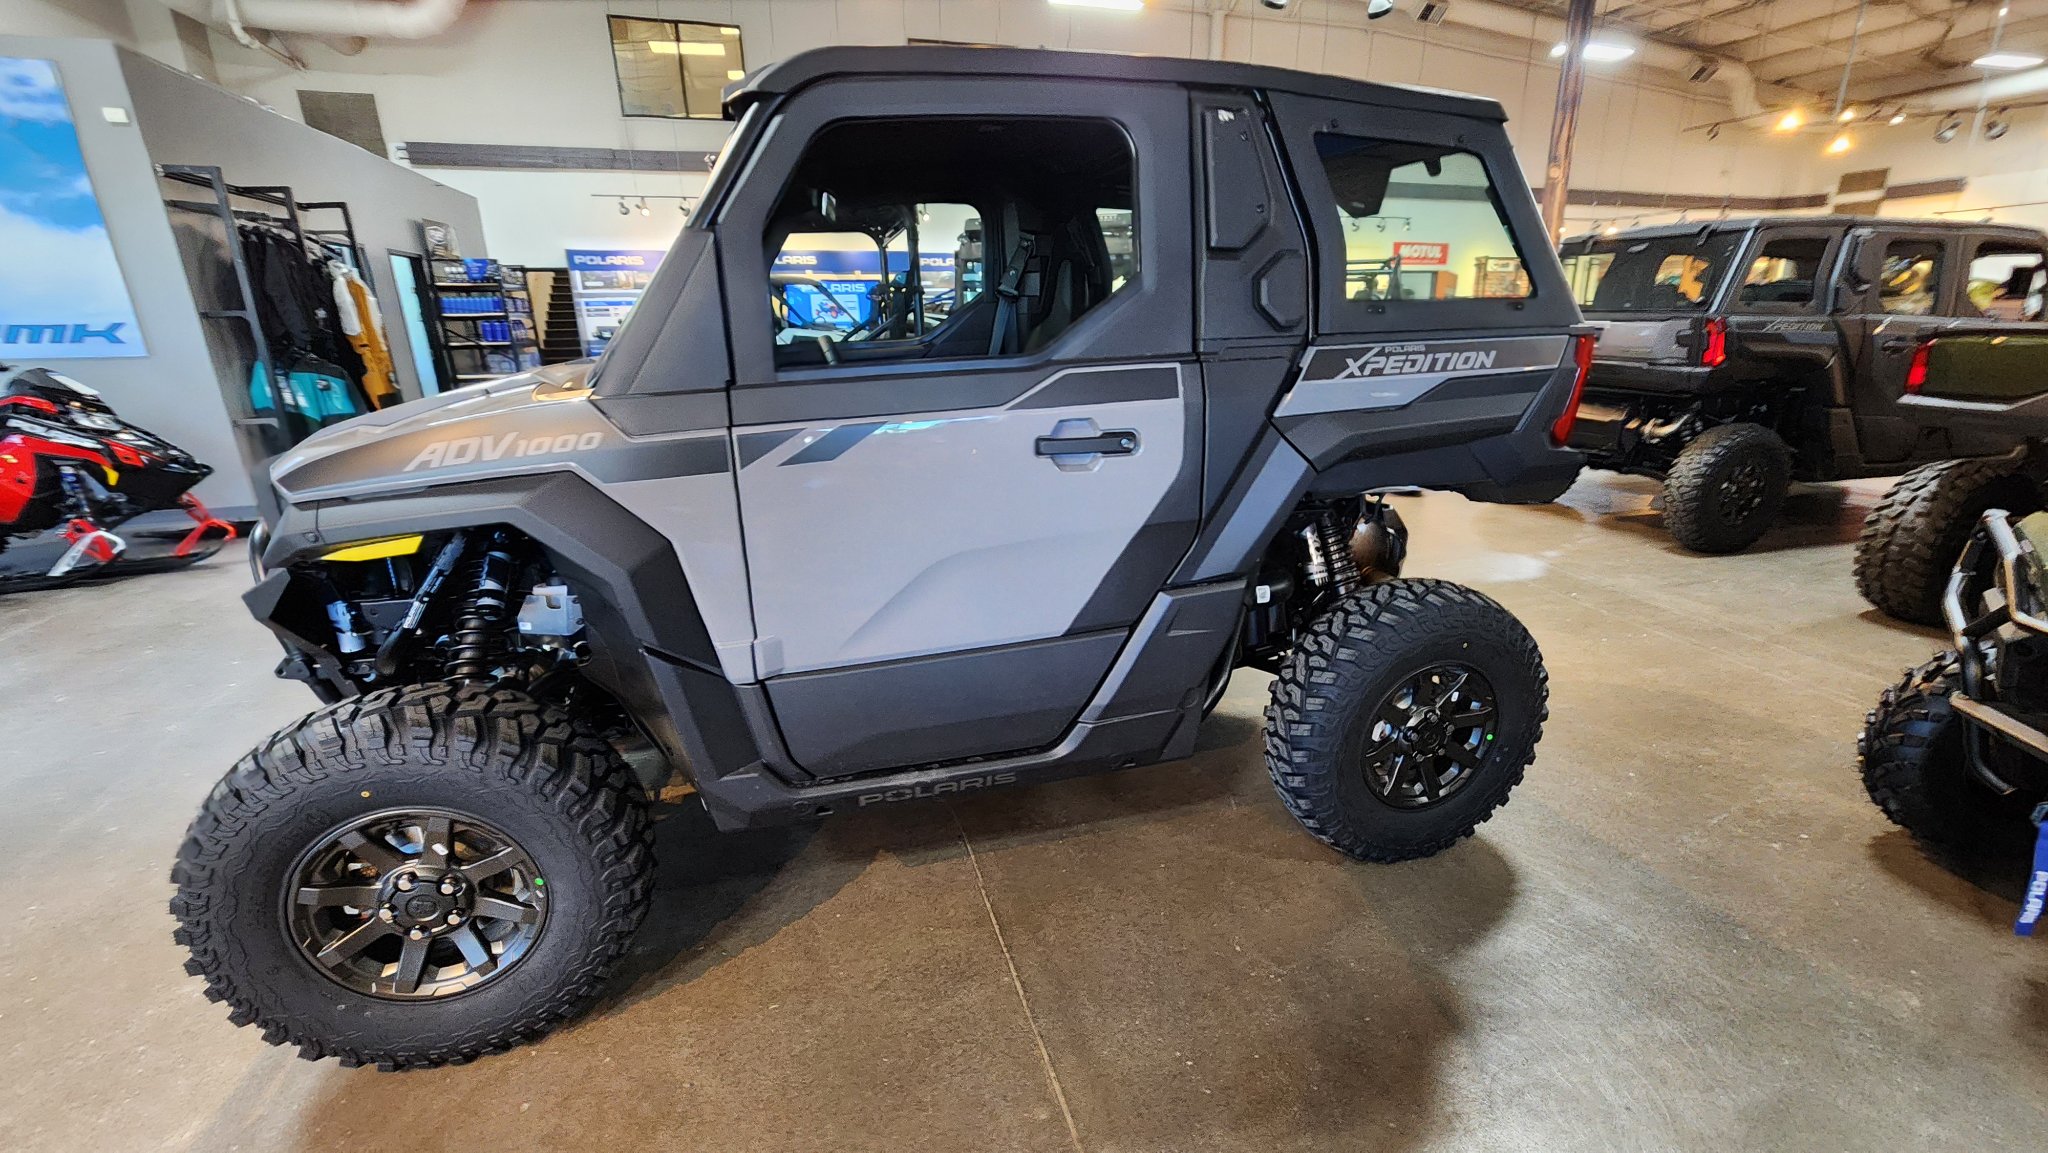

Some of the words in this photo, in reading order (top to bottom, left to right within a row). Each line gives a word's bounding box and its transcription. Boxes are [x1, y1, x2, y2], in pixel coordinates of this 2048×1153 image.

[1399, 244, 1442, 258] MOTUL
[573, 255, 645, 266] POLARIS
[774, 255, 817, 265] LARIS
[919, 257, 956, 267] POLA
[0, 322, 126, 344] MK
[1384, 344, 1426, 354] POLARIS
[1334, 347, 1497, 379] XPEDITION
[405, 432, 519, 471] ADV
[515, 432, 602, 457] 1000
[857, 772, 1017, 807] POLARIS
